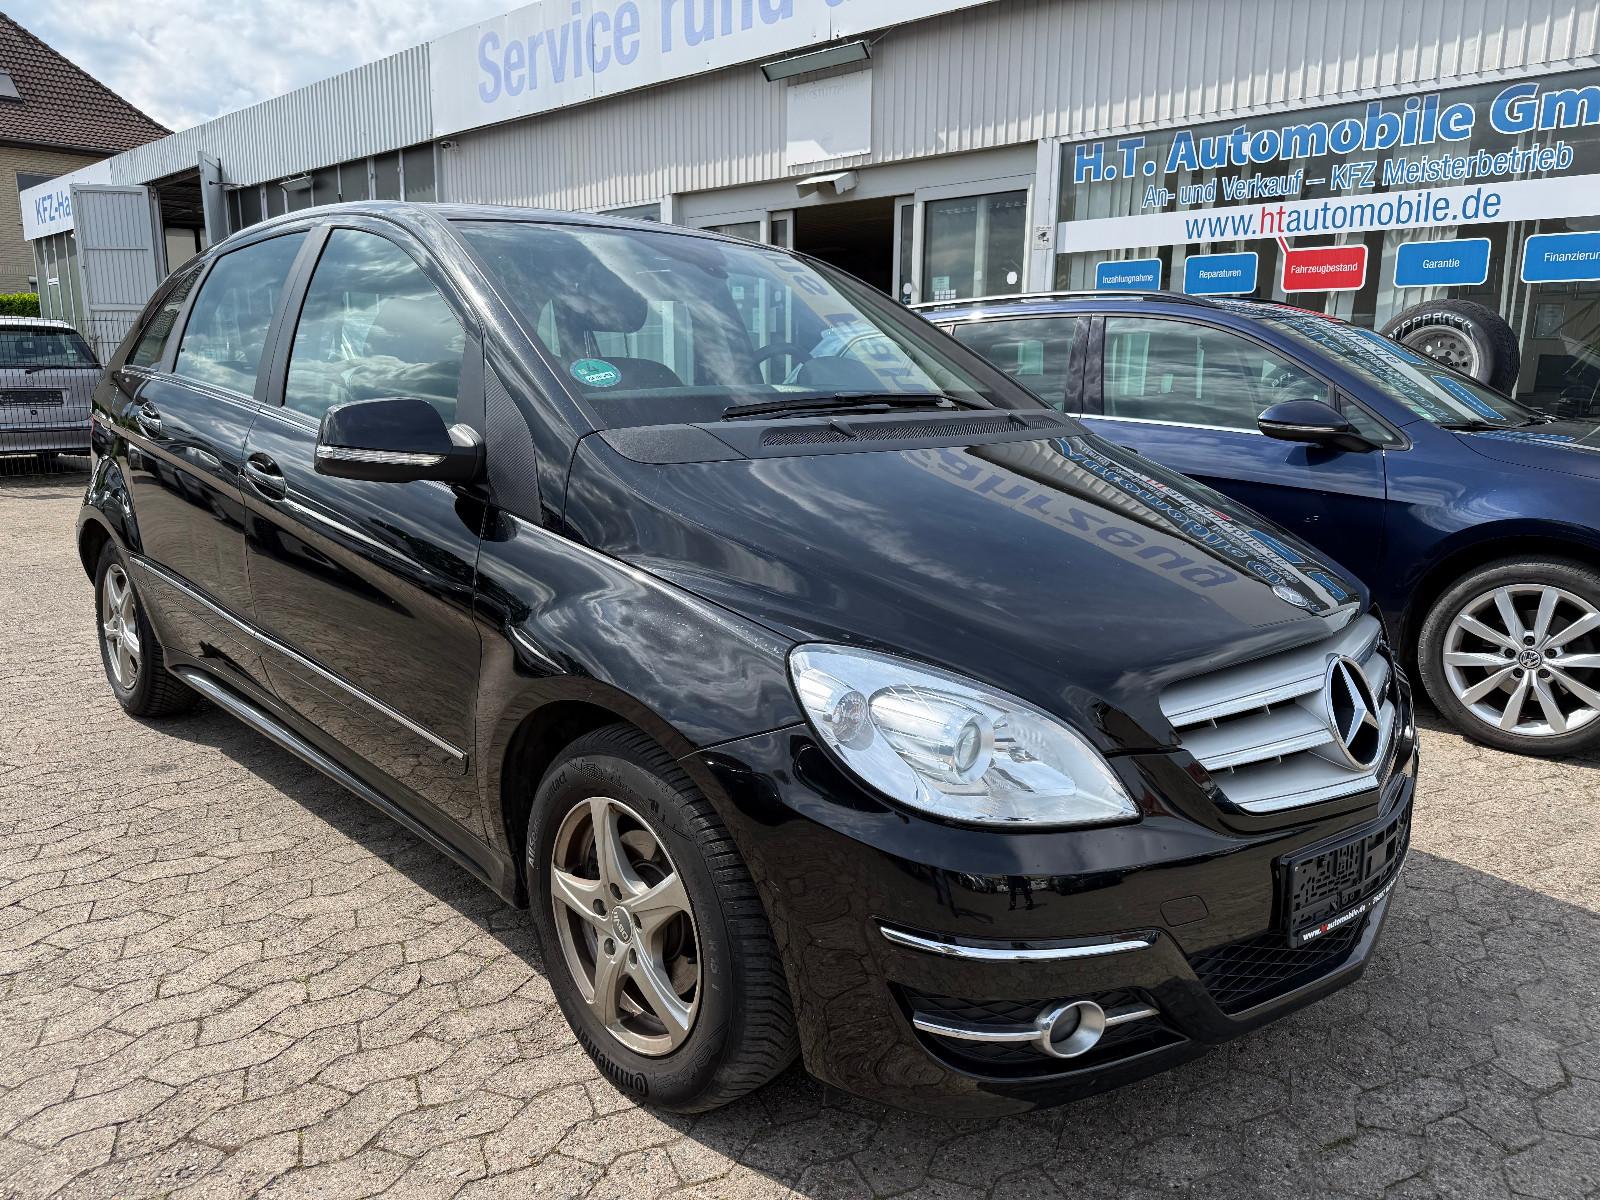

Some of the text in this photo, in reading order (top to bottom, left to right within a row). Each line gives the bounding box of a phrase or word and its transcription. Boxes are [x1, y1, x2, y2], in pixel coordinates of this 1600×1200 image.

[477, 0, 794, 104] Service run
[1073, 82, 1600, 184] H.T. Automobile Gm
[1141, 184, 1176, 209] An-
[1179, 176, 1218, 206] und
[1222, 168, 1304, 201] Verkauf
[1330, 160, 1378, 191] KFZ
[1381, 140, 1575, 187] Meisterbetrieb
[1185, 187, 1502, 240] www.htautomobile.de
[1102, 272, 1154, 285] Inzahlungnahme
[1199, 268, 1242, 280] Reparaturen
[1290, 261, 1359, 275] Fahrzeugbestand
[1422, 257, 1461, 270] Garantie
